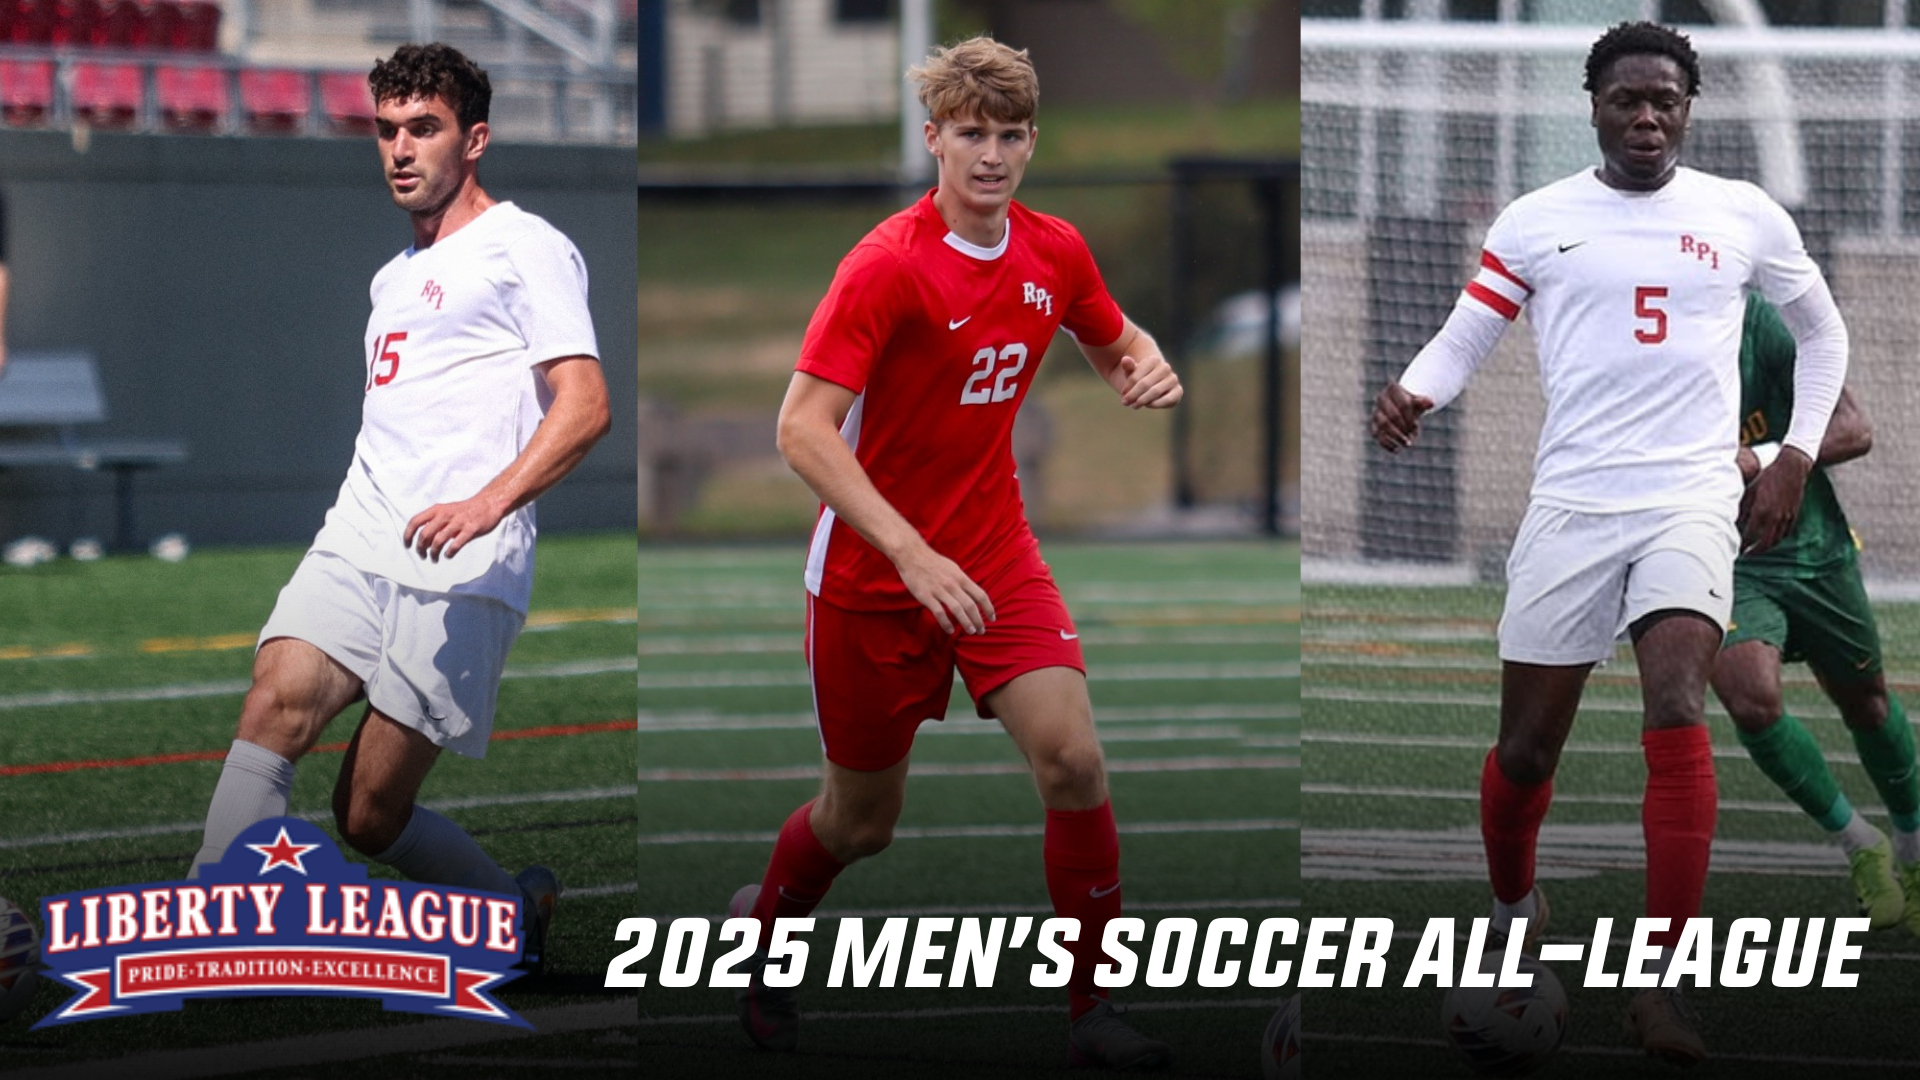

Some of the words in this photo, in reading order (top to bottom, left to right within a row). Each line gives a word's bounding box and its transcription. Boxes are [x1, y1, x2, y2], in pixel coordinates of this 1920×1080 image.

[1680, 234, 1719, 270] RPI
[420, 279, 446, 310] RPI
[1022, 281, 1053, 317] RPI
[1634, 286, 1669, 345] 5
[365, 331, 408, 392] 15
[959, 342, 1029, 406] 22
